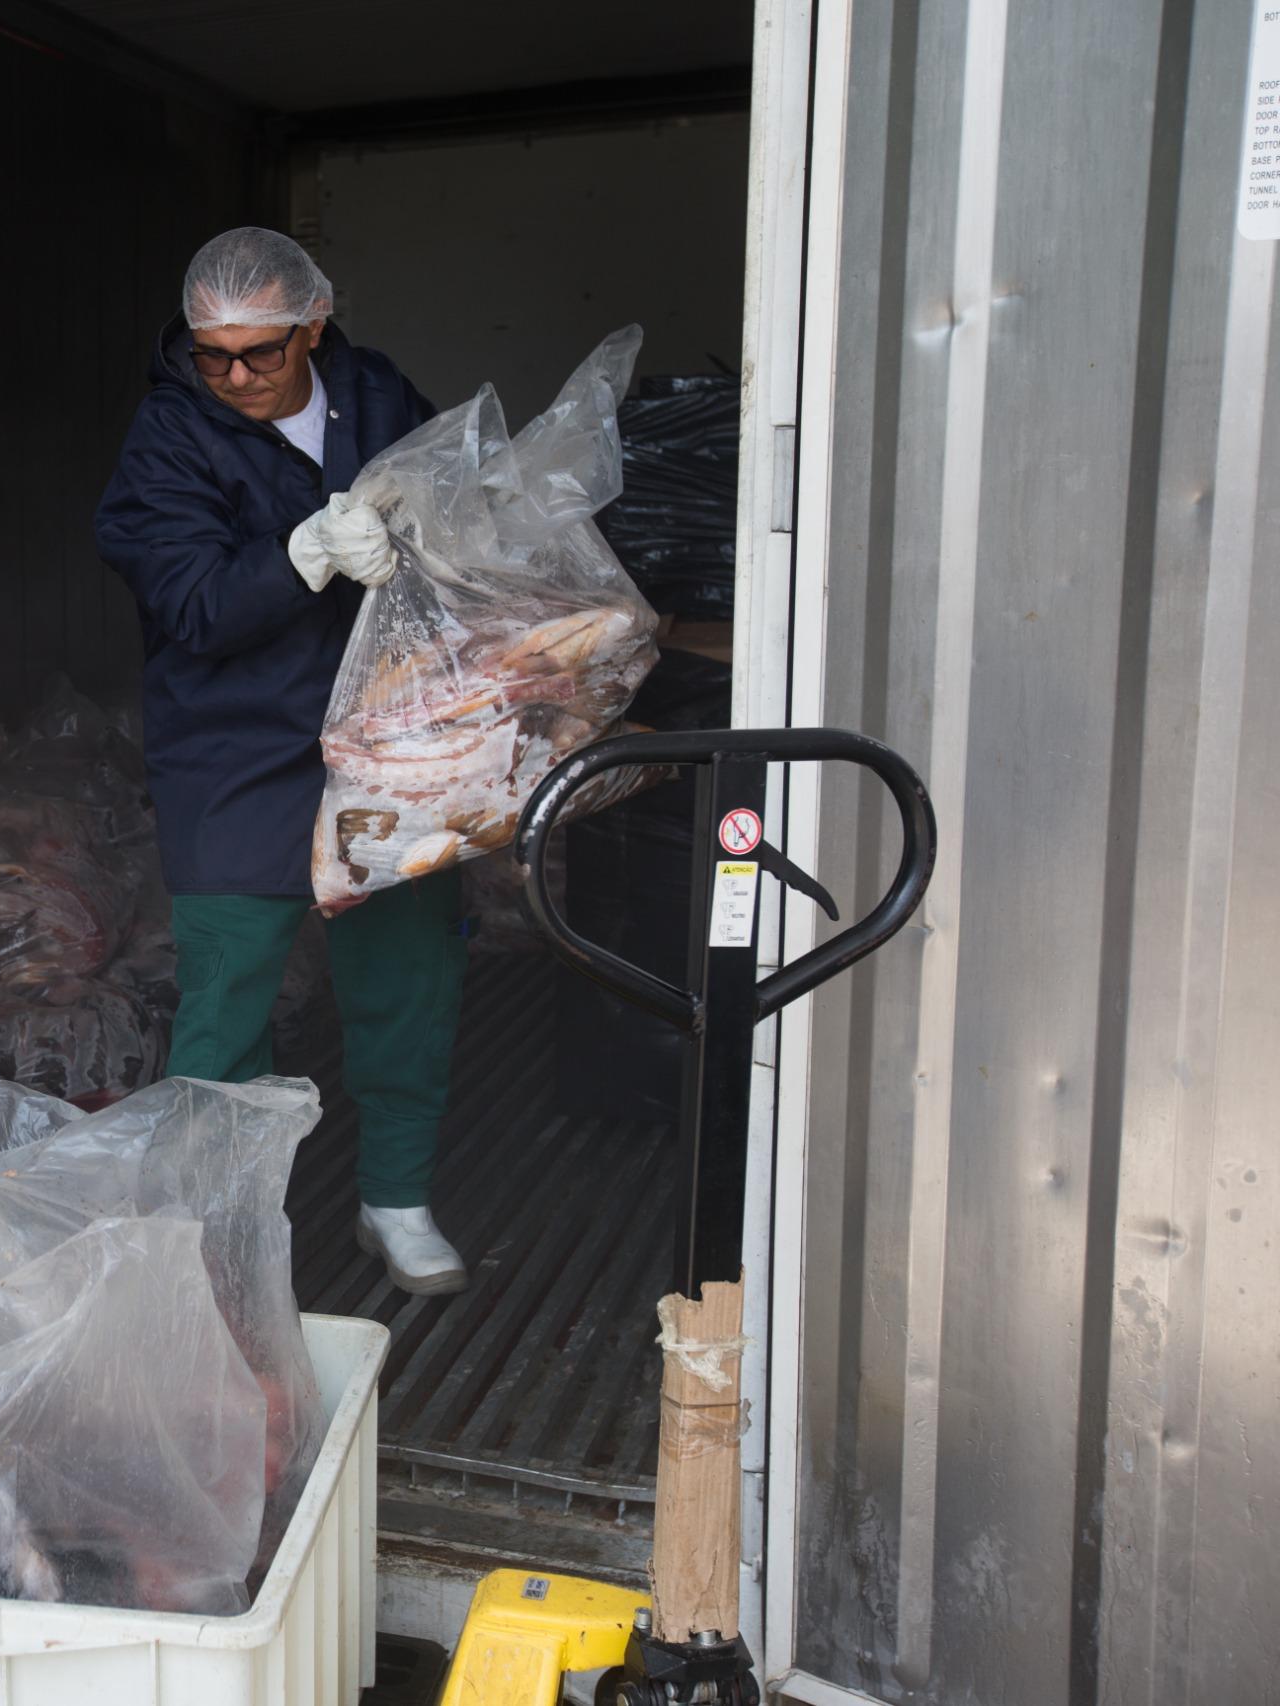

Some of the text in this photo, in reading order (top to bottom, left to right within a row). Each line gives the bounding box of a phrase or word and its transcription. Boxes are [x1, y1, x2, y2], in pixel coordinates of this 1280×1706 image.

[1257, 95, 1274, 105] SIDE
[1256, 110, 1278, 120] DOOR
[1255, 126, 1270, 135] TOP
[1251, 155, 1271, 165] BASE
[1249, 185, 1277, 195] TUNNEL
[1247, 200, 1269, 210] DOOR
